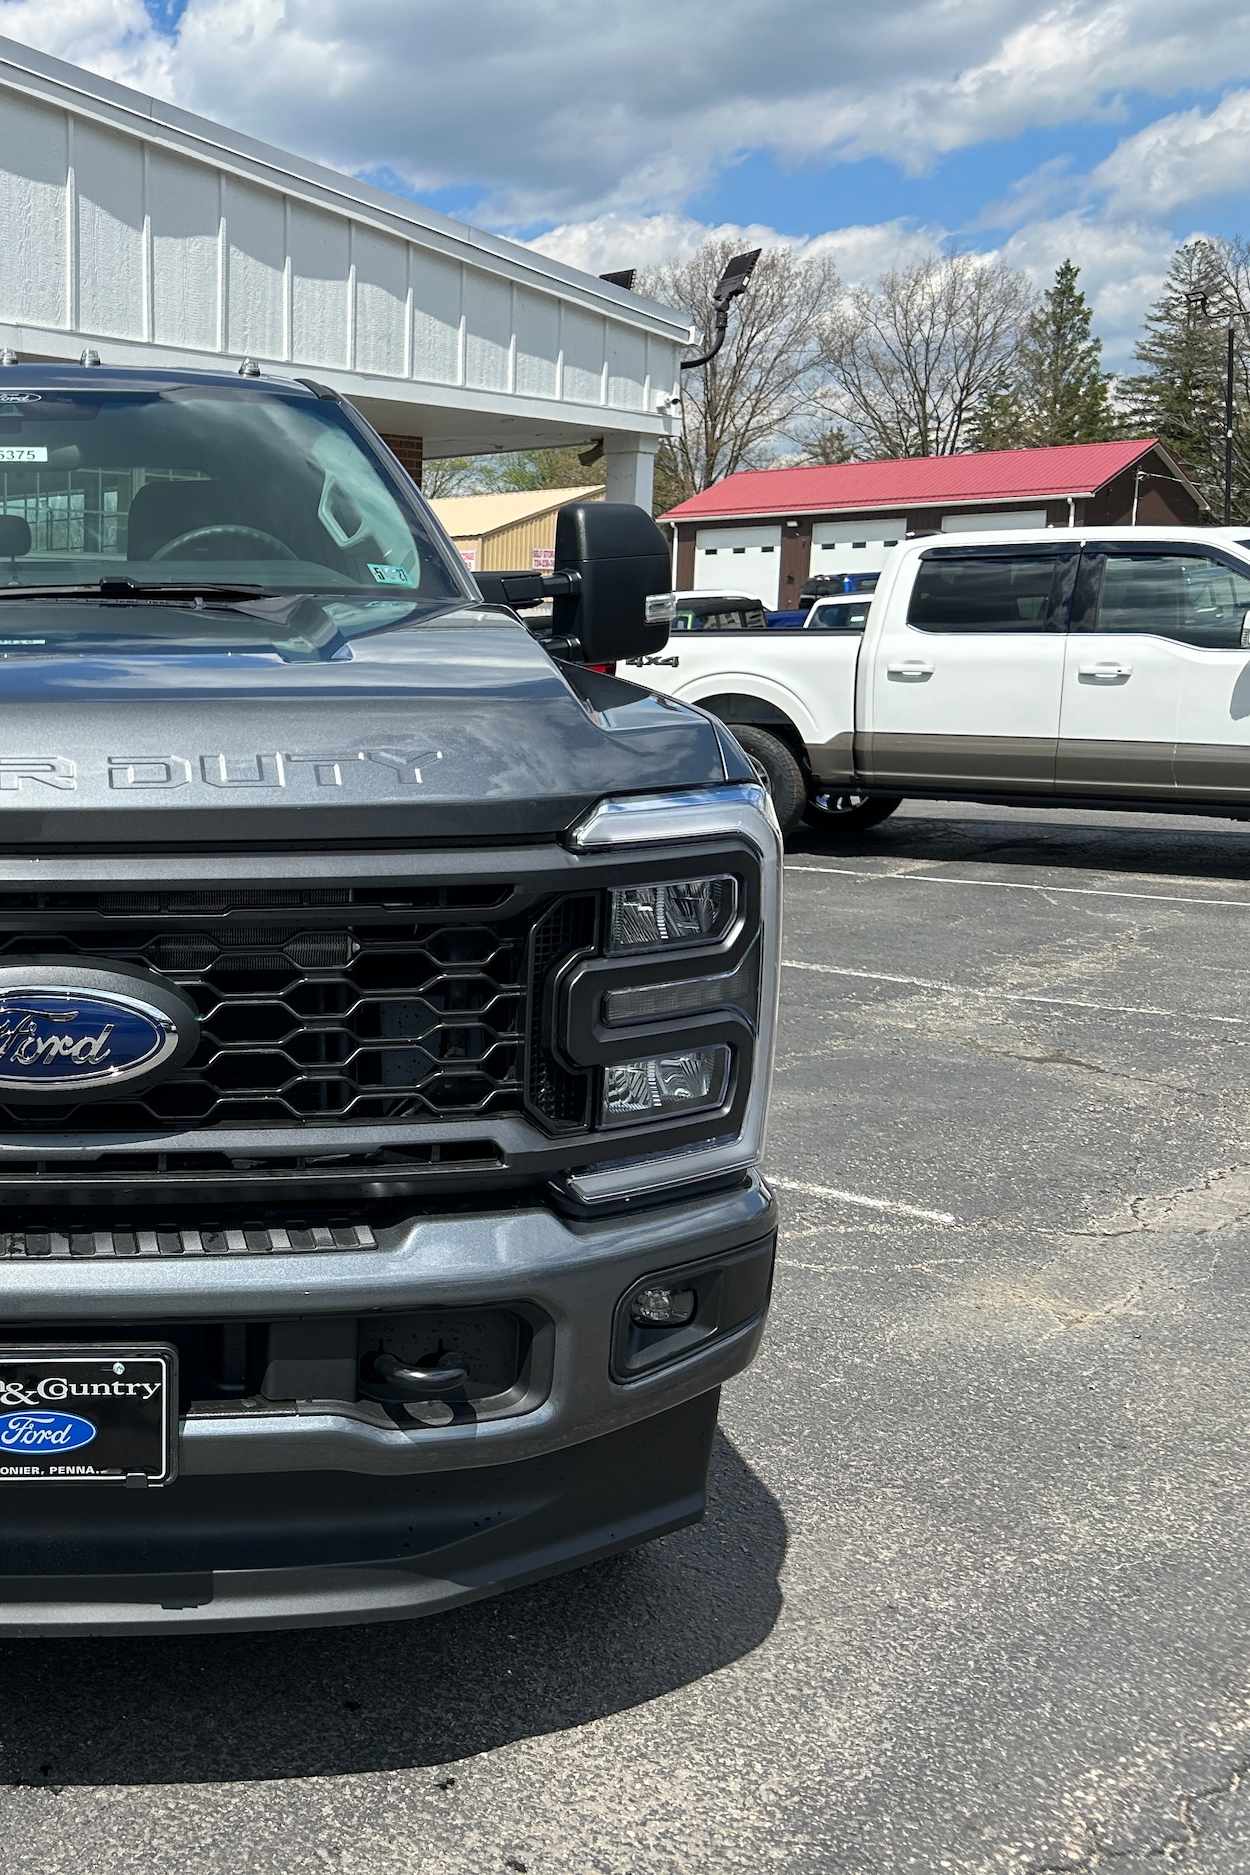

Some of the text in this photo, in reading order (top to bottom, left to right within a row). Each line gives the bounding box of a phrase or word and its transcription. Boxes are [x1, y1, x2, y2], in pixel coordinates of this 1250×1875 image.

[107, 751, 443, 789] DUTY
[0, 1415, 72, 1445] Ford
[49, 1466, 100, 1475] PENNA.
